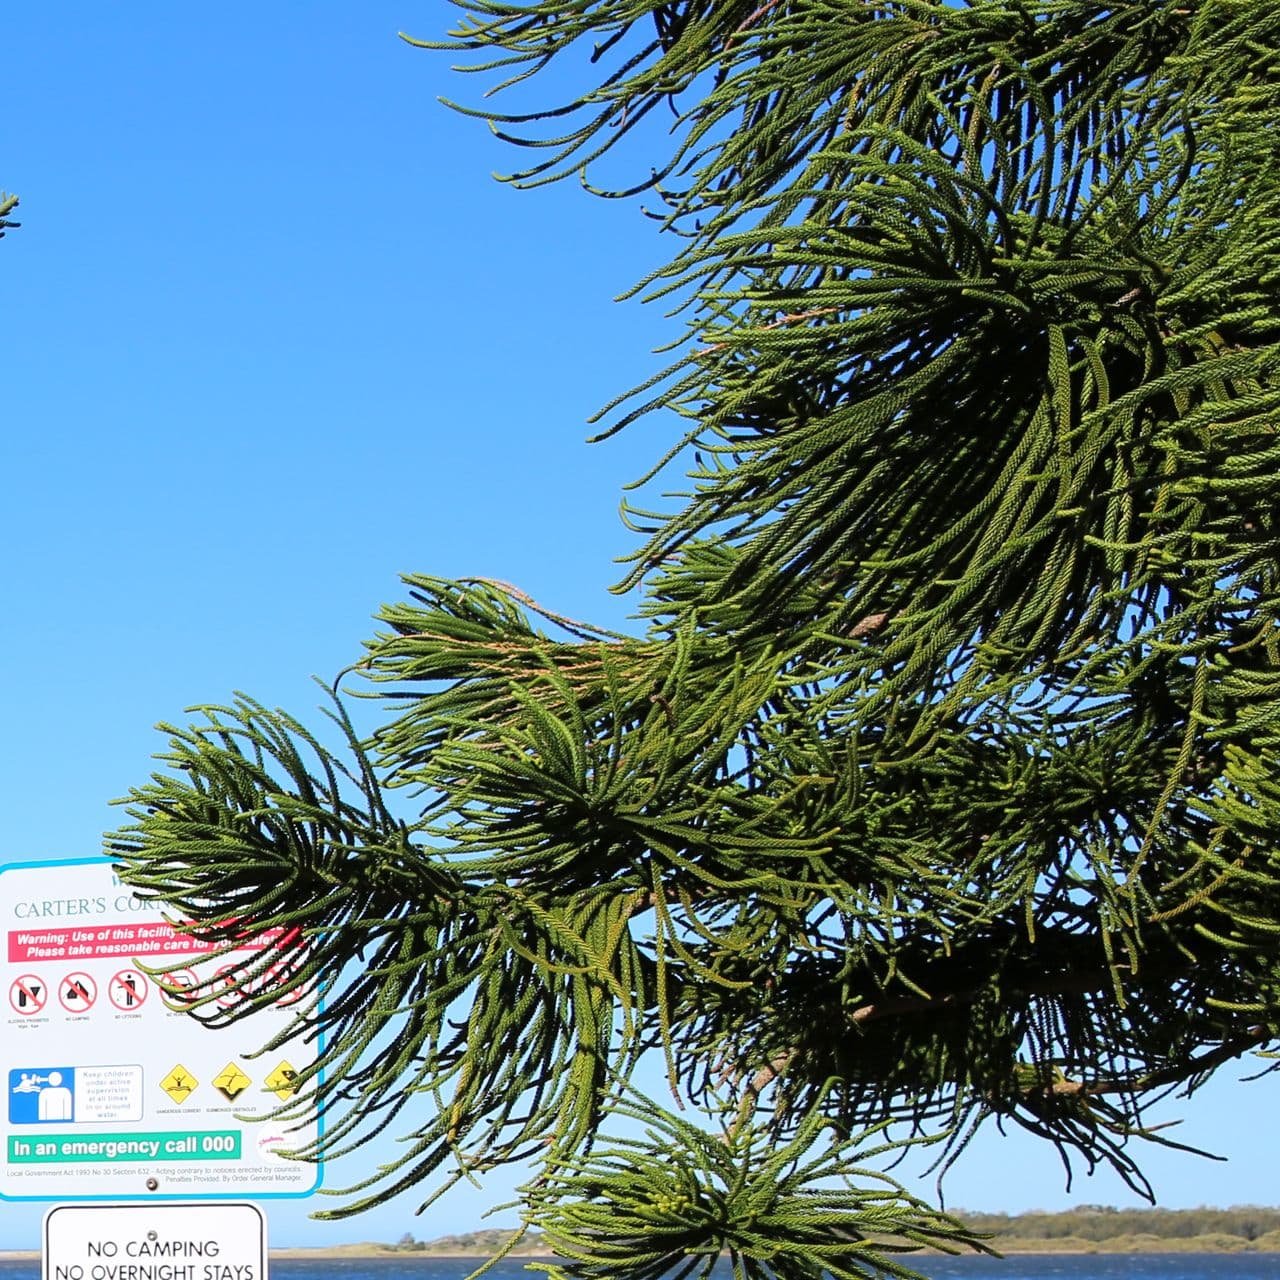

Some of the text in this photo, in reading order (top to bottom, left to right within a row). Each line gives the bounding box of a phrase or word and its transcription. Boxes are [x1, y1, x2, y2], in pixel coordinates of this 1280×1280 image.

[114, 893, 190, 912] CORN
[17, 932, 69, 945] Warning:
[72, 931, 94, 942] Use
[97, 929, 112, 940] of
[112, 929, 134, 940] this
[138, 926, 175, 940] facility
[27, 945, 65, 957] Please
[68, 944, 93, 955] take
[95, 941, 160, 954] reasonable
[163, 940, 190, 951] care
[14, 1135, 235, 1158] In an emergency call 000
[87, 1240, 220, 1257] NO CAMPING
[55, 1264, 254, 1280] NO OVERNIGHT STAYS
